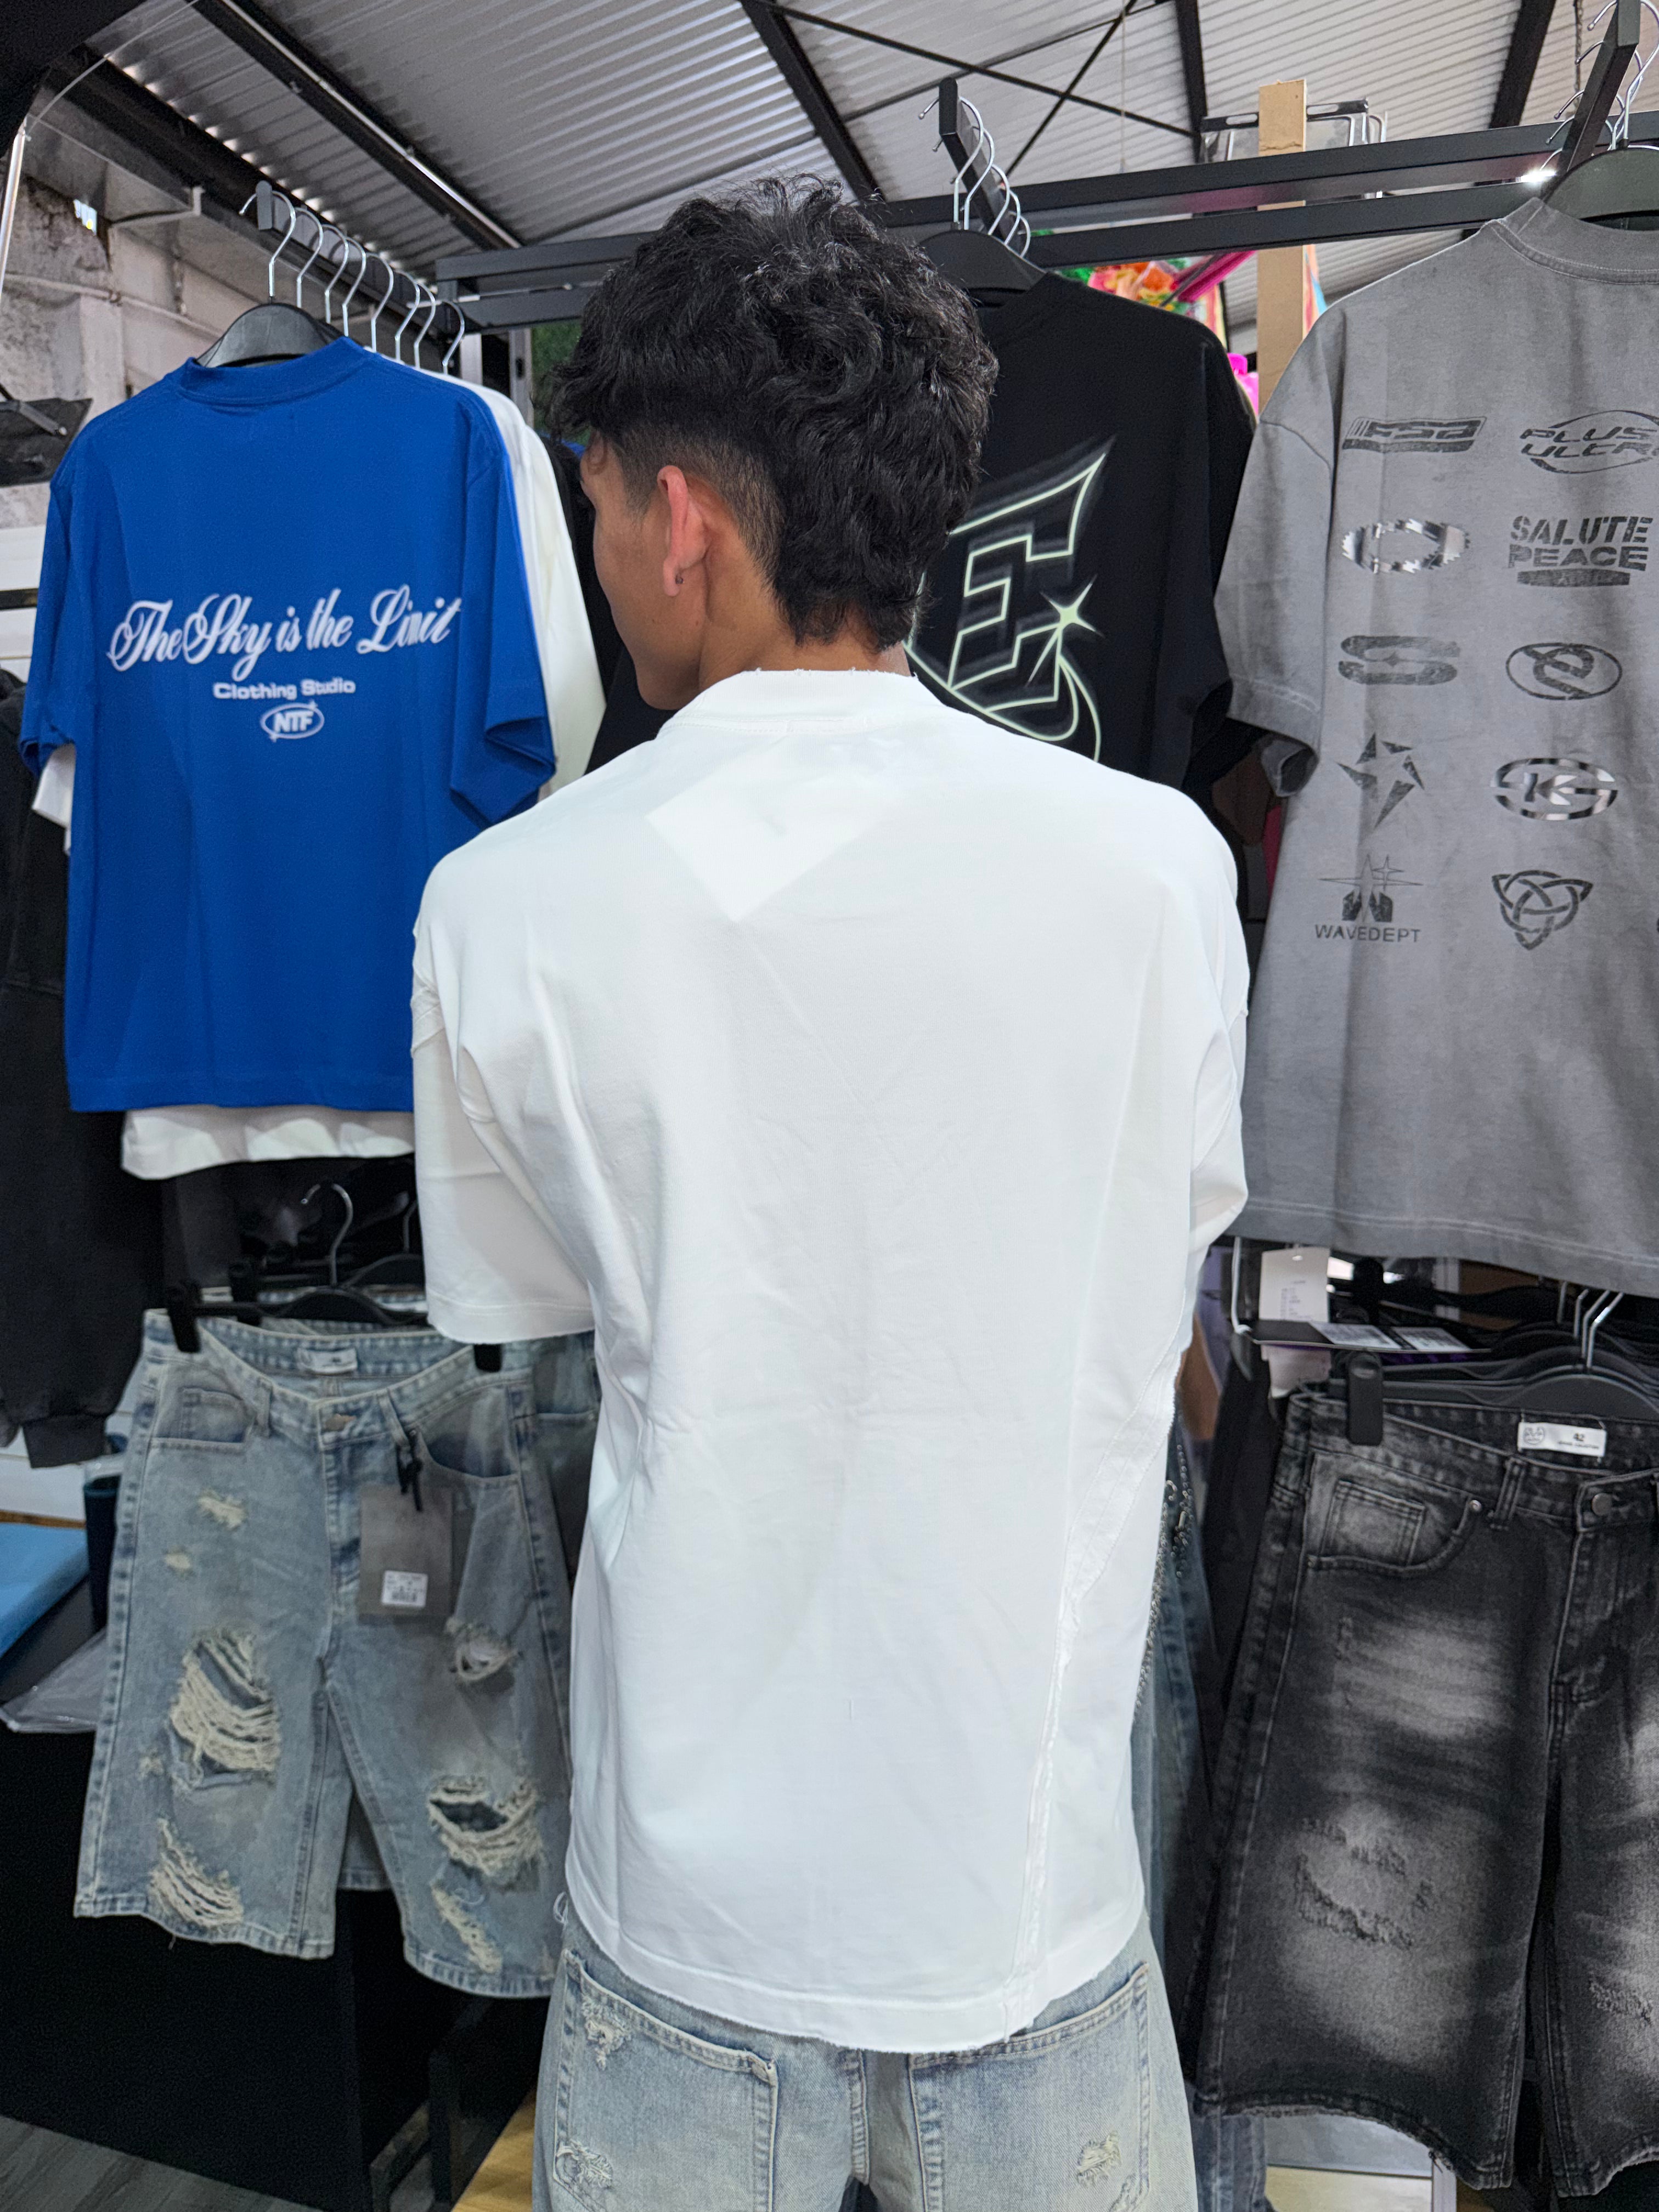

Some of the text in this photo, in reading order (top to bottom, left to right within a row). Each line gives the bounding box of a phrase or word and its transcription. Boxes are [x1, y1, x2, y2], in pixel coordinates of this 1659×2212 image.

[1519, 426, 1657, 443] PLUS
[1510, 516, 1653, 545] SALUTE
[1508, 544, 1649, 571] PEACE
[106, 600, 184, 672] The
[183, 593, 272, 682] Sky
[275, 606, 302, 652] is
[306, 588, 354, 651] the
[212, 676, 356, 701] Clothing Studio
[274, 710, 314, 733] NTF
[1315, 924, 1421, 943] WAVEDEPT
